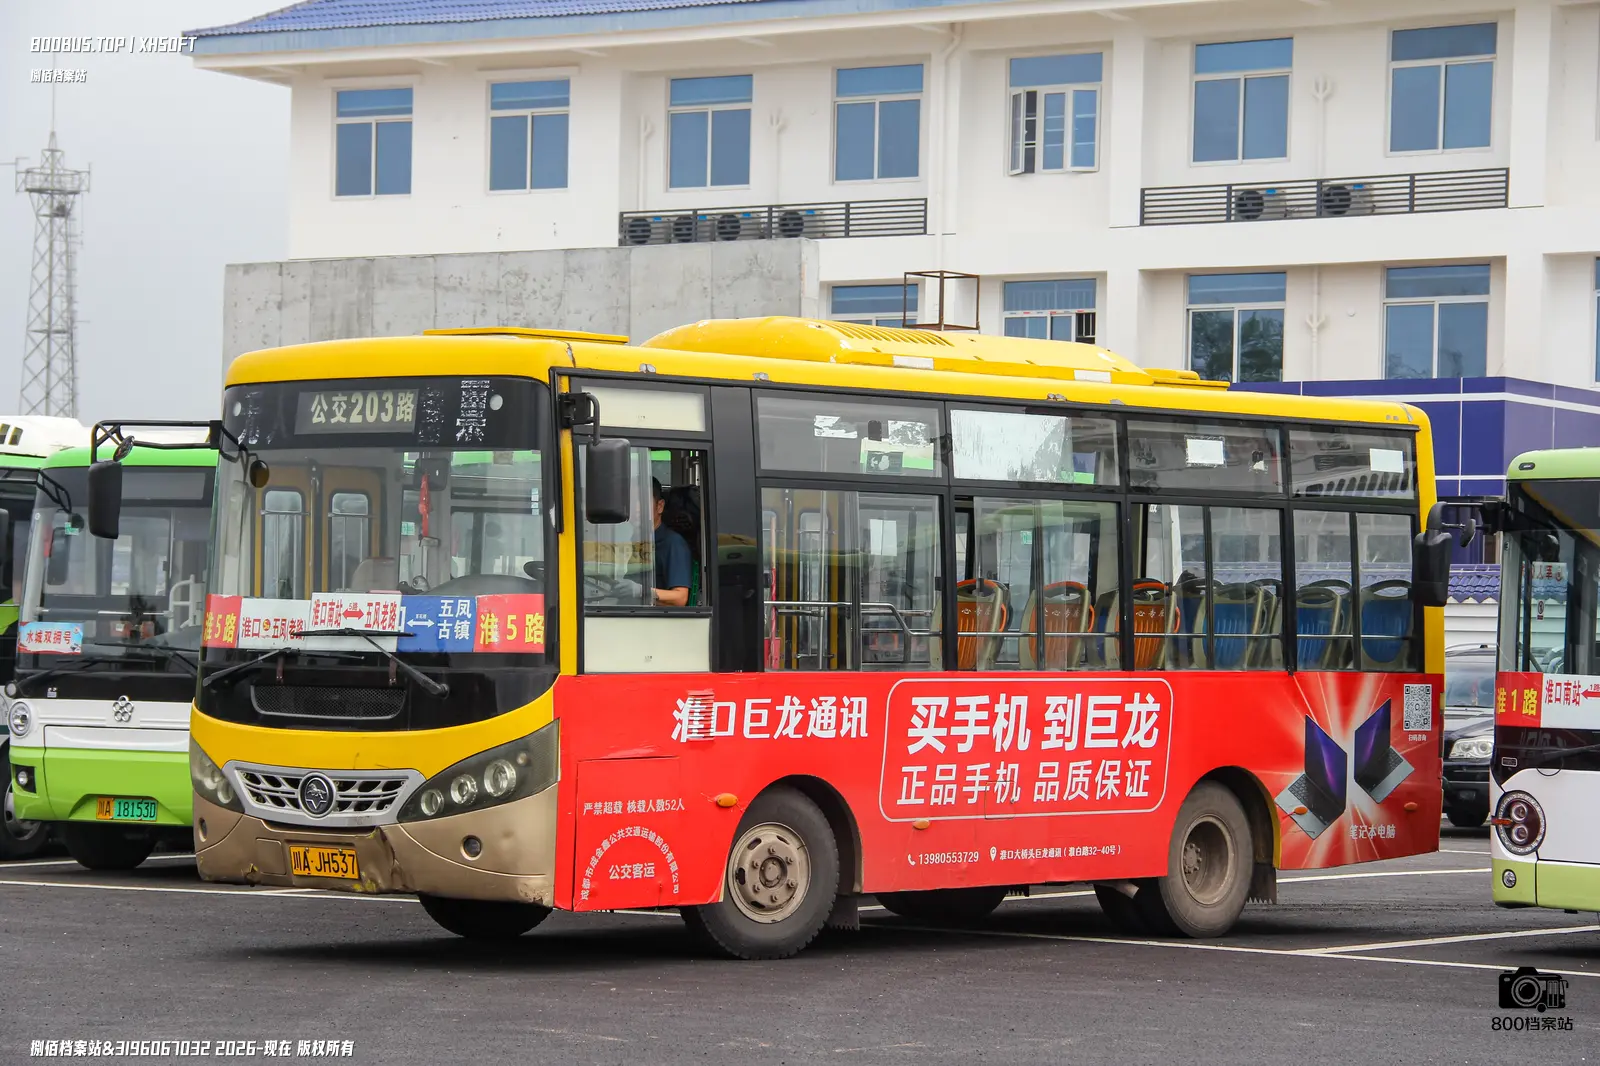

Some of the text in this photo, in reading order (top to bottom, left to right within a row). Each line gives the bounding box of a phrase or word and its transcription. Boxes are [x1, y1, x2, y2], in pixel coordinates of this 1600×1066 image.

[311, 390, 416, 425] 公交203路
[312, 599, 342, 627] 淮口南站
[438, 599, 472, 619] 五凤
[26, 630, 72, 645] 水城双拥号
[438, 619, 471, 640] 古镇
[480, 612, 544, 645] 淮5路
[1545, 679, 1581, 706] 淮口南站
[671, 696, 868, 742] 淮口巨龙通讯
[907, 693, 1160, 754] 买手机 到巨龙
[897, 760, 1152, 805] 正品手机 品质保证
[583, 798, 685, 816] 严禁超载 核载人数52人
[1350, 824, 1396, 840] 笔记本电脑
[918, 851, 980, 866] 13980553729
[608, 862, 655, 880] 公交客运
